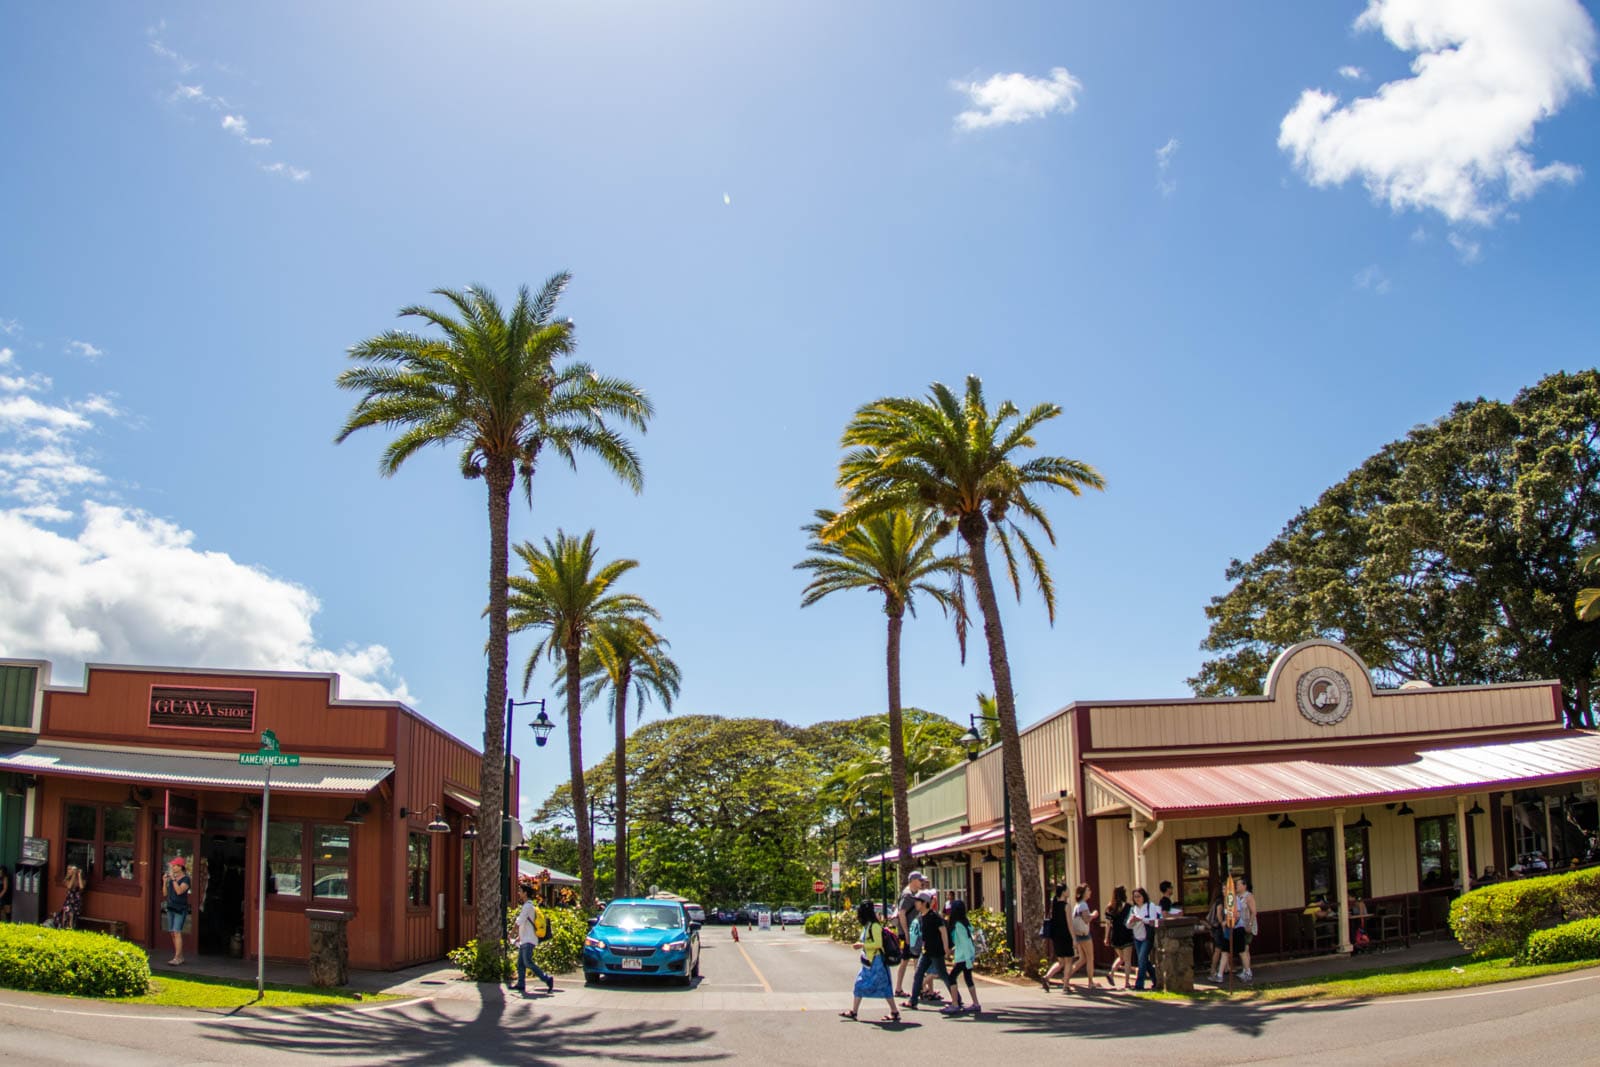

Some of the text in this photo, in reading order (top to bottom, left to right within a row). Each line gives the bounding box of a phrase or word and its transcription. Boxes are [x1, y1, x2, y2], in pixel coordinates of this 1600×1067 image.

[155, 699, 248, 718] GUAVA SHOP
[240, 755, 288, 765] KAMEHAMEHA
